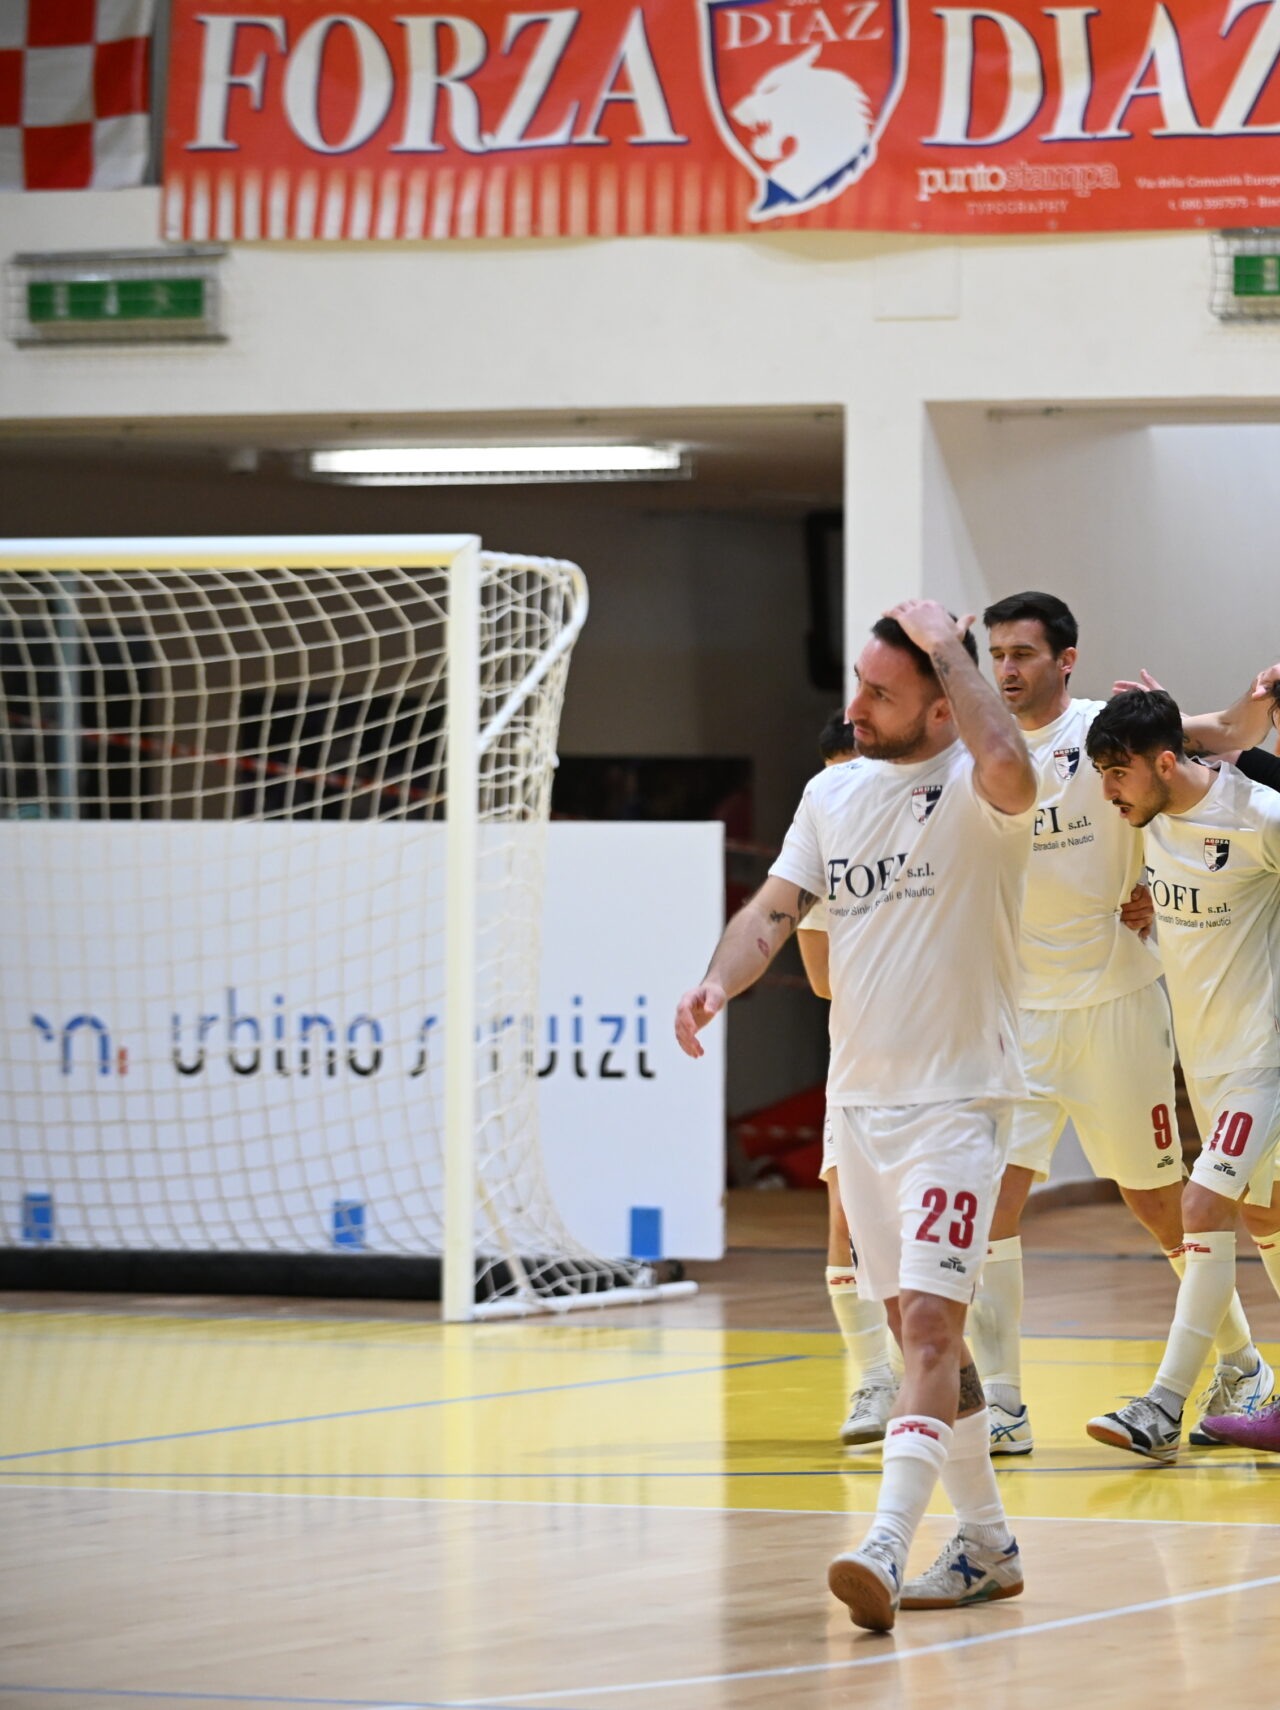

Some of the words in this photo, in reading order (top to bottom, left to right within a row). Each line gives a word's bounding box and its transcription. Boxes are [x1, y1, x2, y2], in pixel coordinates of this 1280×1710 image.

[722, 1, 885, 50] DIAZ
[183, 6, 689, 155] FORZA
[965, 200, 1070, 216] TYPOGRAPHY
[172, 987, 383, 1077] urbino
[409, 994, 656, 1078] srvizi
[1151, 1103, 1172, 1150] 9
[1208, 1110, 1253, 1157] 10
[915, 1187, 978, 1249] 23
